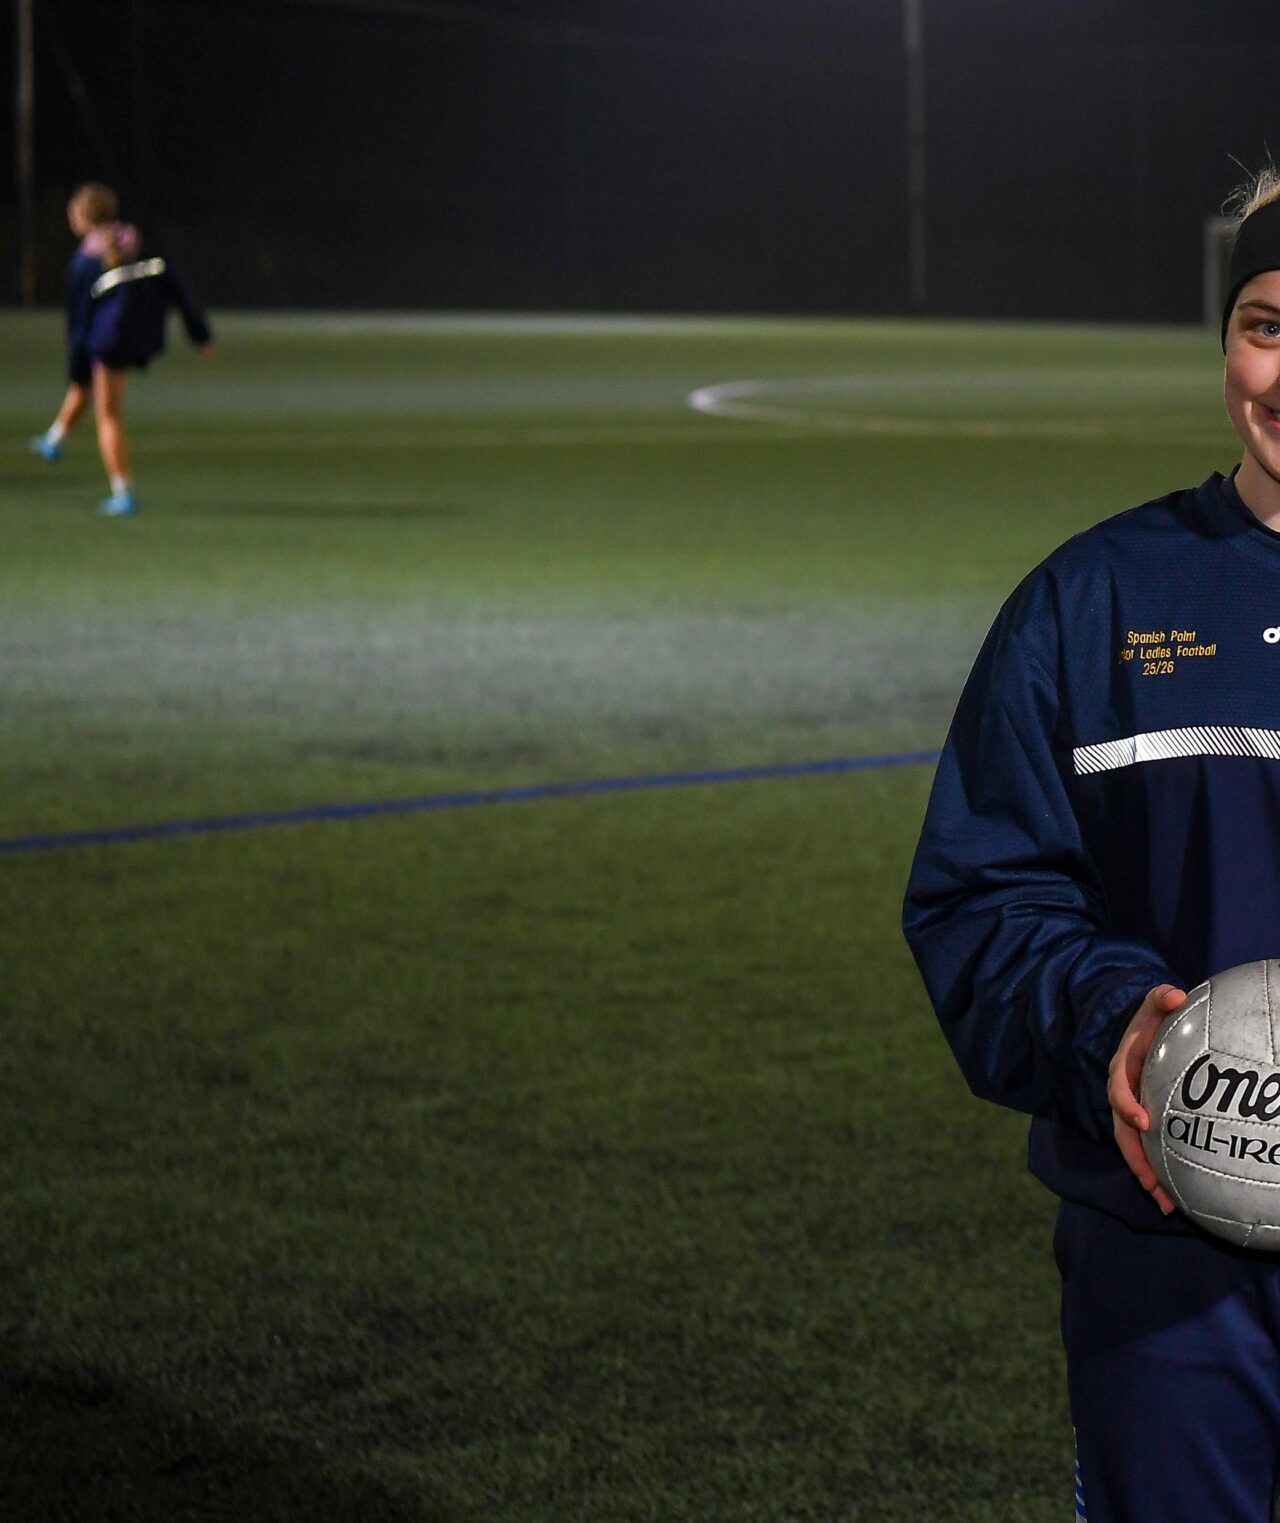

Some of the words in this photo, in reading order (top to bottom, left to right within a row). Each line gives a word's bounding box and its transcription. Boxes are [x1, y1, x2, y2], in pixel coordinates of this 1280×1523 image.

[1127, 630, 1166, 646] Spanish
[1170, 629, 1197, 642] Point
[1140, 645, 1172, 660] Ladies
[1176, 643, 1217, 657] Football
[1142, 660, 1175, 676] 25/26
